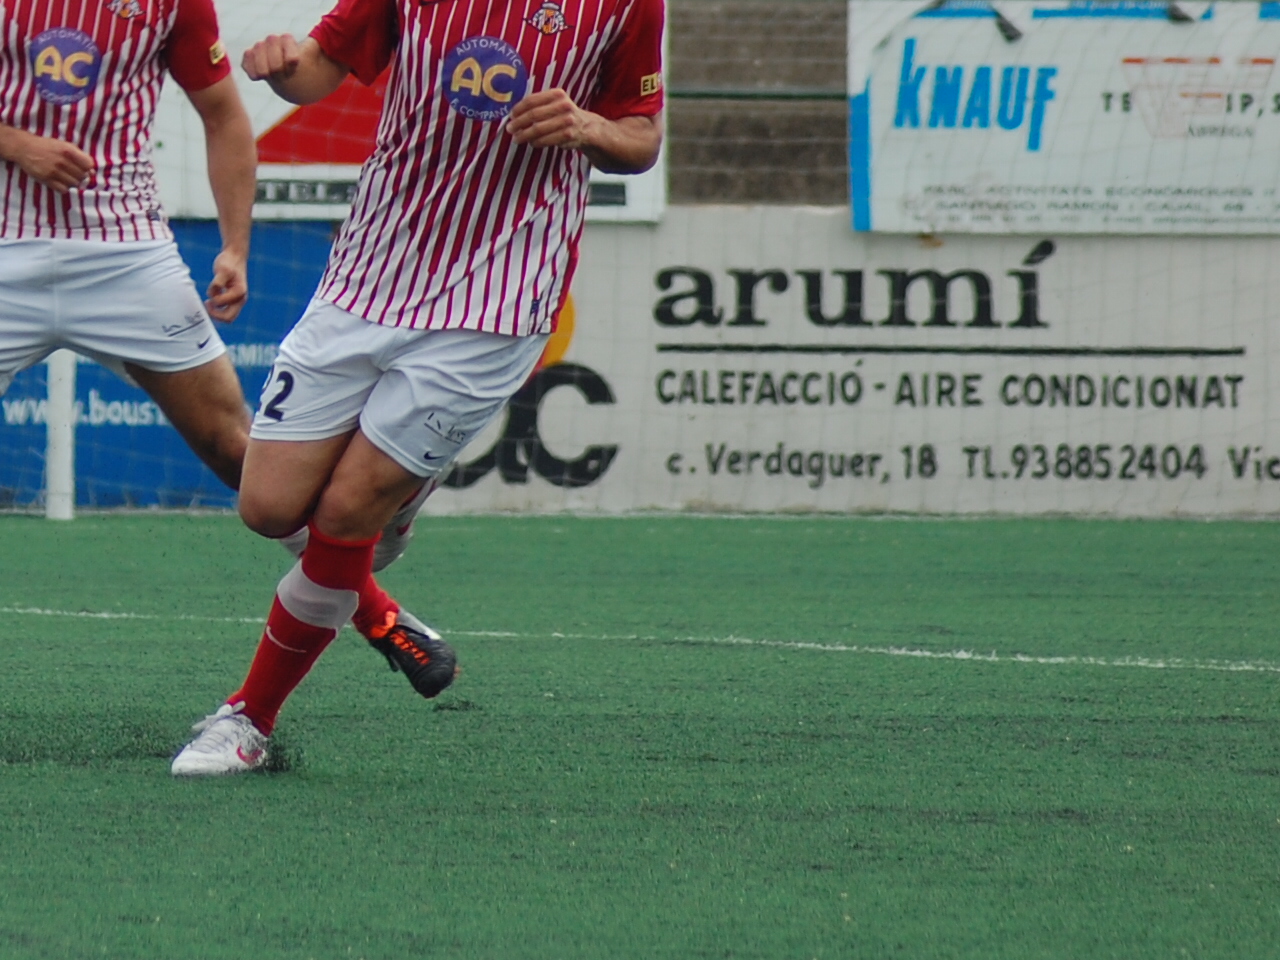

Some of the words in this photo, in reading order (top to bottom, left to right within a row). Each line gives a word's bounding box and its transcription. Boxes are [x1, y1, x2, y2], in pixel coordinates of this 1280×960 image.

[33, 45, 95, 88] AC
[450, 57, 518, 103] AC
[459, 104, 511, 120] COMPANY
[892, 36, 1059, 152] KNAUF
[652, 239, 1057, 330] arumí
[1000, 372, 1245, 410] CONDICIONAT
[665, 452, 697, 477] c.
[705, 442, 891, 490] Verdaguer,
[901, 443, 938, 480] 18
[1226, 445, 1280, 481] Vic
